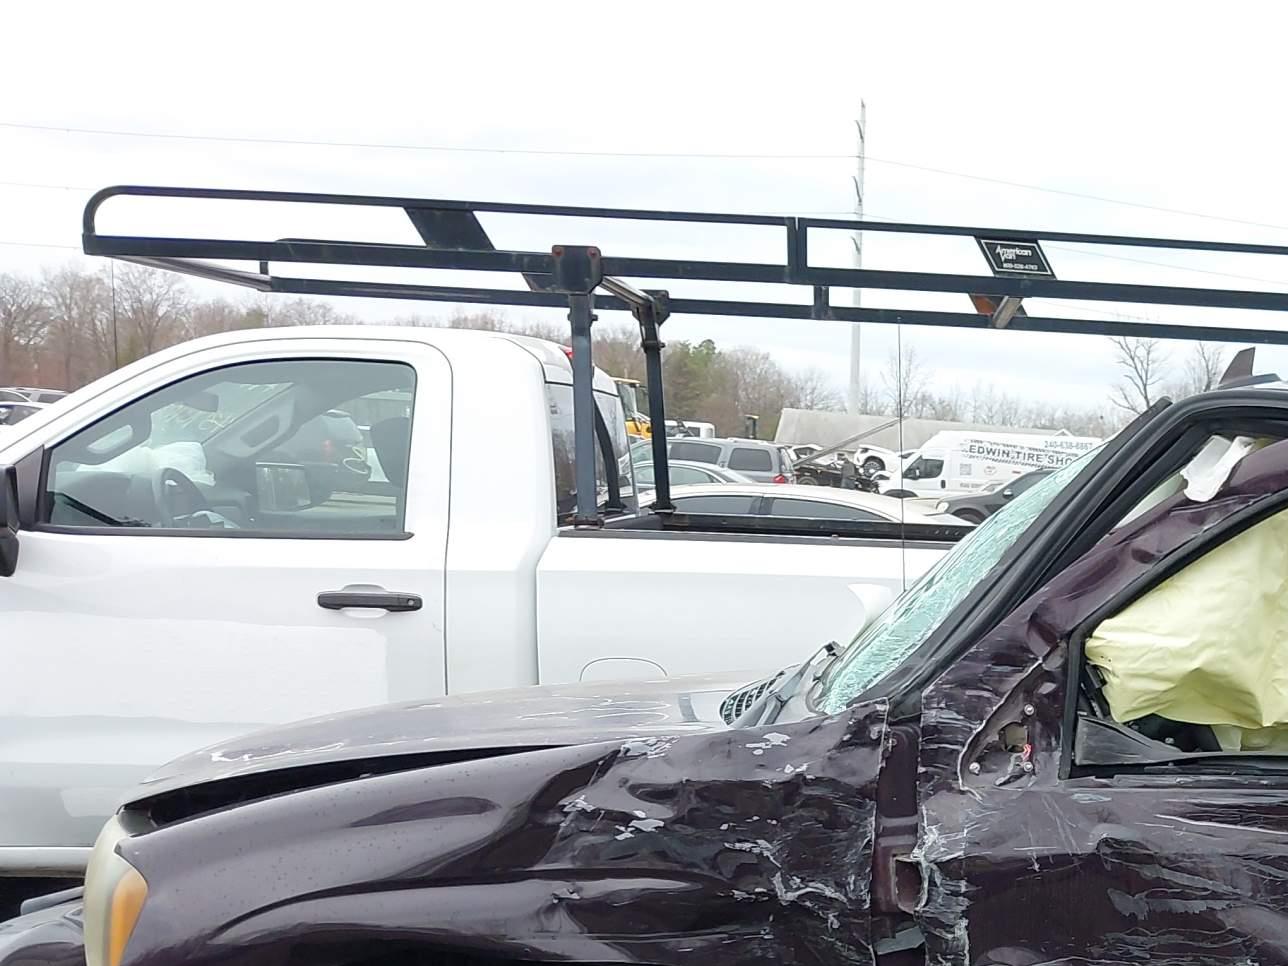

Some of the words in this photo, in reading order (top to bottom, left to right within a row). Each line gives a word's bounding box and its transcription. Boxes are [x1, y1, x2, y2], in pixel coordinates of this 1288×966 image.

[995, 245, 1032, 257] American
[968, 445, 1010, 458] EDWIN
[1015, 452, 1043, 463] TIRE
